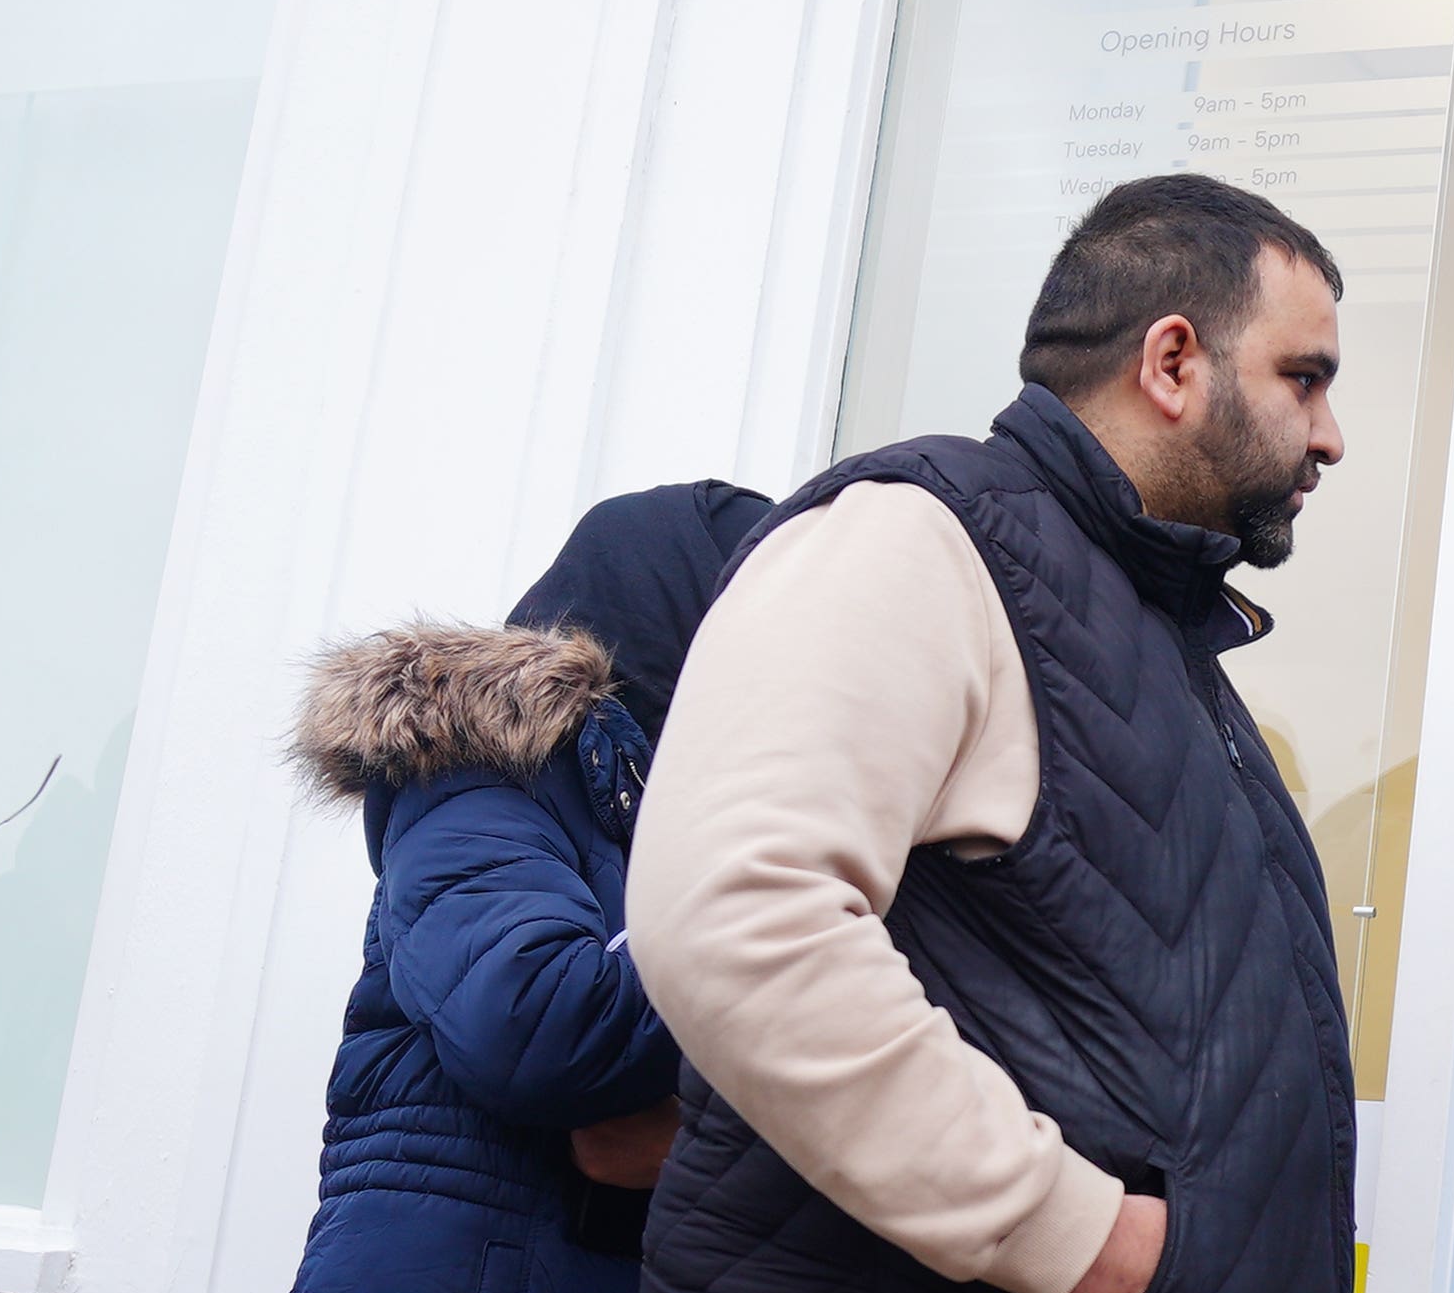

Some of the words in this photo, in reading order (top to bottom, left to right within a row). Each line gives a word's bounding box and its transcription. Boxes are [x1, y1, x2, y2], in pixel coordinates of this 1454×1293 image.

[1100, 26, 1210, 57] Opening
[1219, 21, 1296, 45] Hours
[1068, 101, 1146, 122] Monday
[1193, 96, 1237, 114] 9am
[1261, 92, 1307, 113] 5pm
[1062, 139, 1144, 159] Tuesday
[1187, 134, 1231, 152] 9am
[1254, 130, 1301, 152] 5pm
[1251, 168, 1298, 189] 5pm
